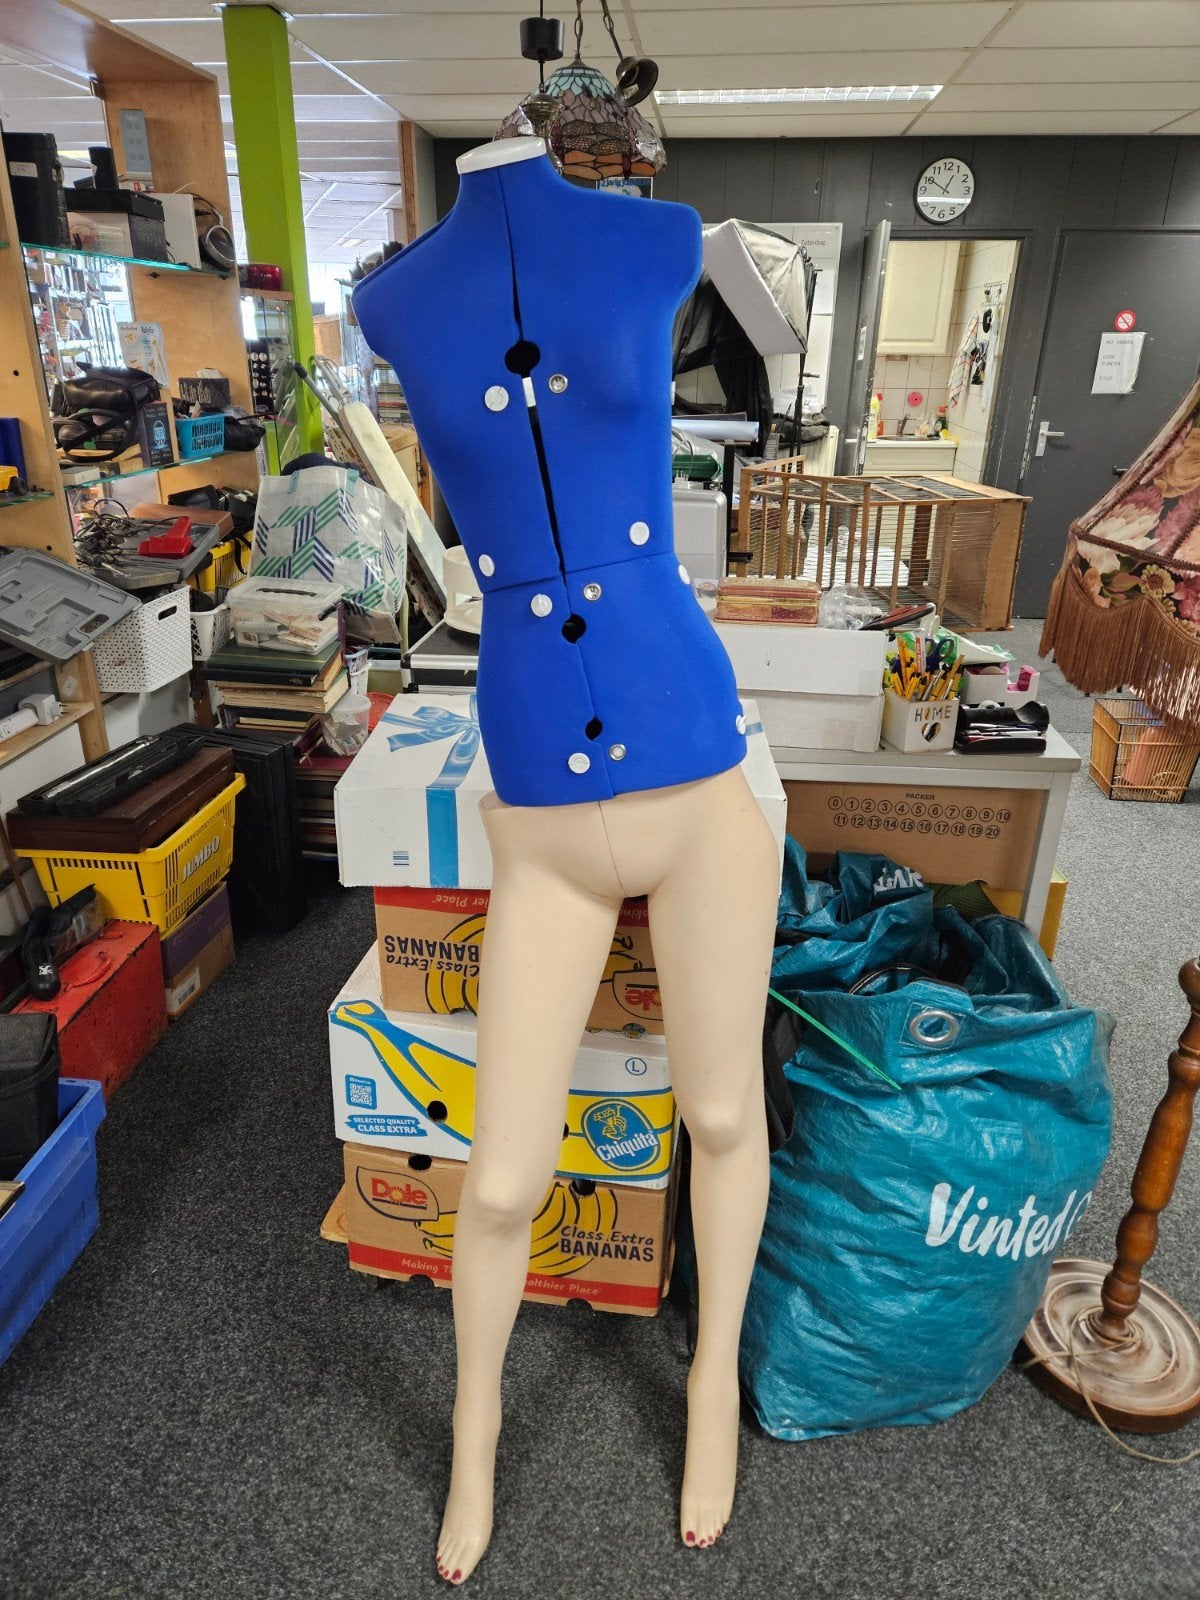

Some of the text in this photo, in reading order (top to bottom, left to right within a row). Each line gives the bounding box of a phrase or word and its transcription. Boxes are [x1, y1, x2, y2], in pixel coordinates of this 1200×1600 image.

[932, 166, 941, 175] 11
[943, 161, 954, 171] 12
[956, 165, 960, 173] 1
[924, 176, 935, 185] 10
[961, 174, 969, 183] 2
[919, 185, 927, 195] 9
[963, 186, 971, 195] 3
[930, 206, 937, 215] 7
[938, 209, 946, 219] 6
[949, 207, 956, 215] 5
[914, 705, 953, 722] HOME
[905, 792, 936, 801] PACKER
[183, 835, 221, 885] JUMBO
[384, 934, 480, 963] BANANAS
[386, 954, 480, 977] Class Extra
[632, 1060, 640, 1073] L
[357, 1124, 418, 1134] CLASS EXTRA
[596, 1132, 659, 1161] Chiquita
[371, 1177, 428, 1205] Dole
[925, 1182, 1078, 1261] Vinted
[561, 1225, 654, 1246] Class Extra
[560, 1238, 654, 1262] BANANAS
[401, 1258, 438, 1274] Making
